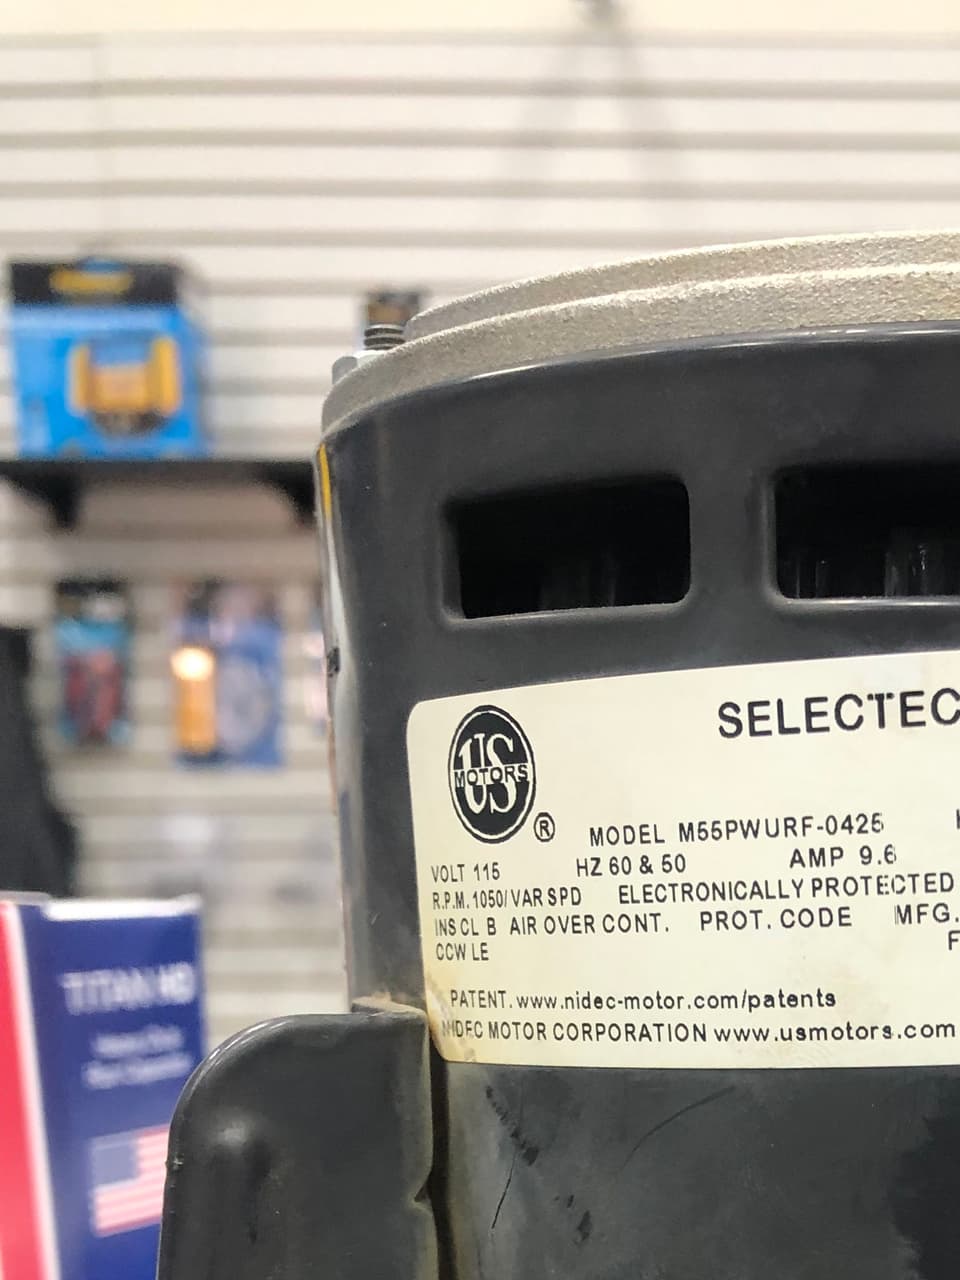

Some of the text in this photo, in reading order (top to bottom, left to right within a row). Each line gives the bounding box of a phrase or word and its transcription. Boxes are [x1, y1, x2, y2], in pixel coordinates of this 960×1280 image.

[454, 764, 529, 788] MOTORS
[589, 823, 666, 847] MODEL
[678, 812, 885, 843] M55PWURF-0425
[431, 863, 465, 883] VOLT
[473, 861, 501, 881] 115
[575, 856, 603, 878] HZ
[608, 855, 632, 876] 60
[638, 854, 654, 875] &
[661, 853, 687, 874] 50
[789, 846, 844, 869] AMP
[859, 843, 897, 866] 9.6
[618, 878, 804, 905] ELECTRONICALLY
[811, 871, 955, 898] PROTECTED
[486, 916, 497, 936] B
[509, 915, 538, 936] AIR
[543, 914, 596, 935] OVER
[602, 912, 669, 934] CONT.
[699, 909, 772, 932] PROT.
[779, 905, 853, 929] CODE
[894, 902, 960, 925] MFG.
[435, 942, 466, 961] CCW
[471, 941, 490, 962] LE
[516, 987, 837, 1014] www.nidec-motor.com/patents
[488, 1021, 547, 1041] MOTOR
[552, 1022, 707, 1043] CORPORATION
[713, 1020, 956, 1043] www.usmotors.com
